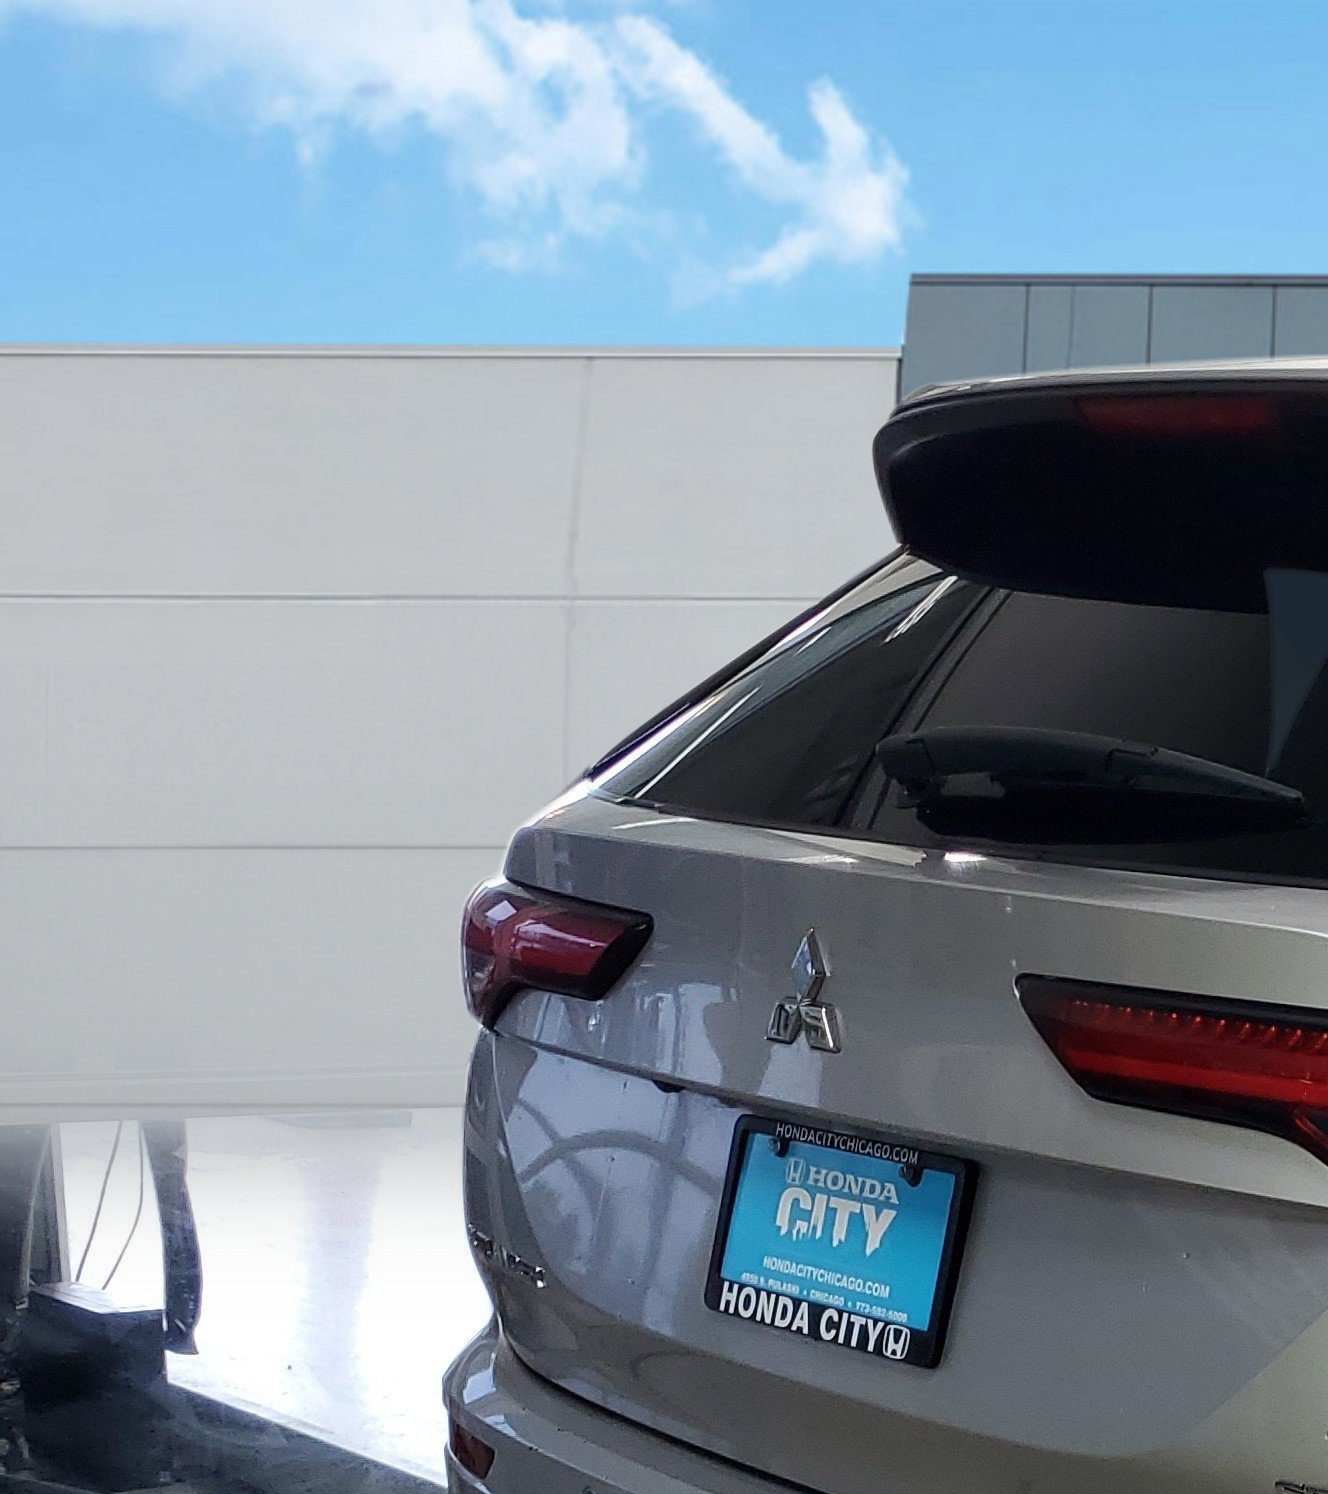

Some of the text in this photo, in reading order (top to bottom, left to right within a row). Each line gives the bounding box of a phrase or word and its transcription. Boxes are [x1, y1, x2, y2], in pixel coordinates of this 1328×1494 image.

[776, 1122, 919, 1165] HONDACITYCHICAGO.COM
[806, 1165, 899, 1204] HONDA
[775, 1187, 897, 1257] CITY
[763, 1256, 890, 1299] HONDACITYCHICAGO.COM
[719, 1281, 885, 1353] HONDA CITY
